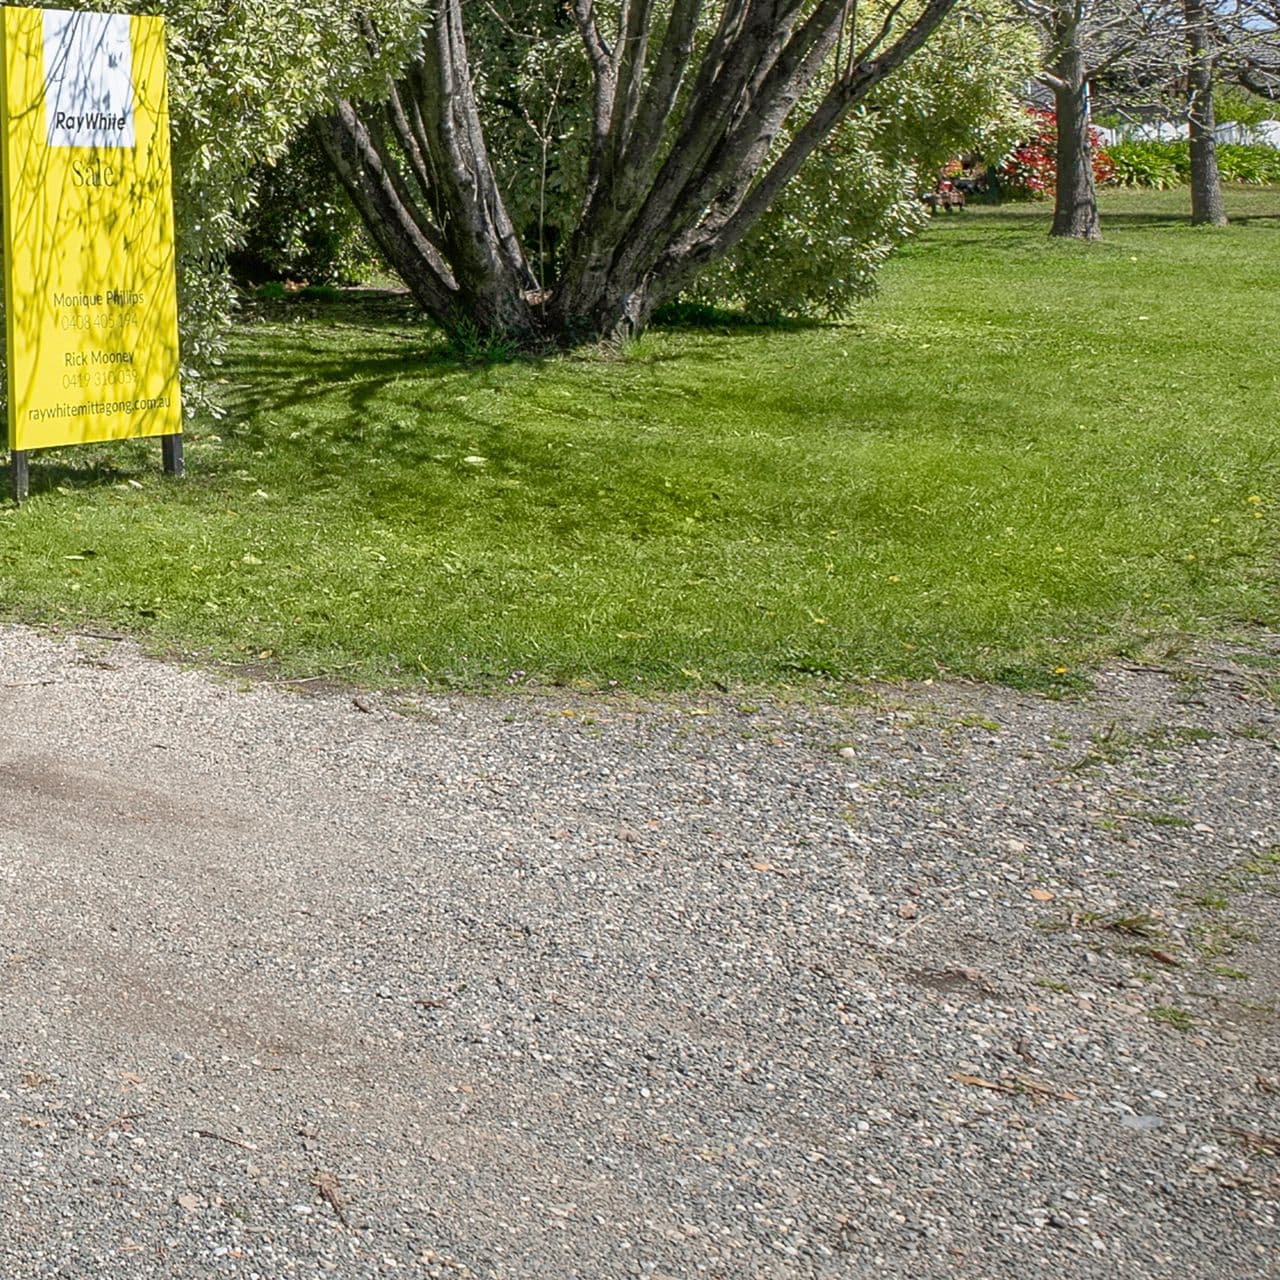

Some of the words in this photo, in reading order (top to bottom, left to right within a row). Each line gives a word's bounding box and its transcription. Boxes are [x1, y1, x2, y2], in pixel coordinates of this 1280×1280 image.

[71, 159, 115, 188] Sale
[53, 291, 103, 308] Monique
[106, 289, 145, 308] Phillips
[61, 314, 91, 330] 0408
[64, 351, 88, 367] Rick
[91, 350, 134, 365] Mooney
[28, 397, 171, 423] raywhitemittagong.com.au
